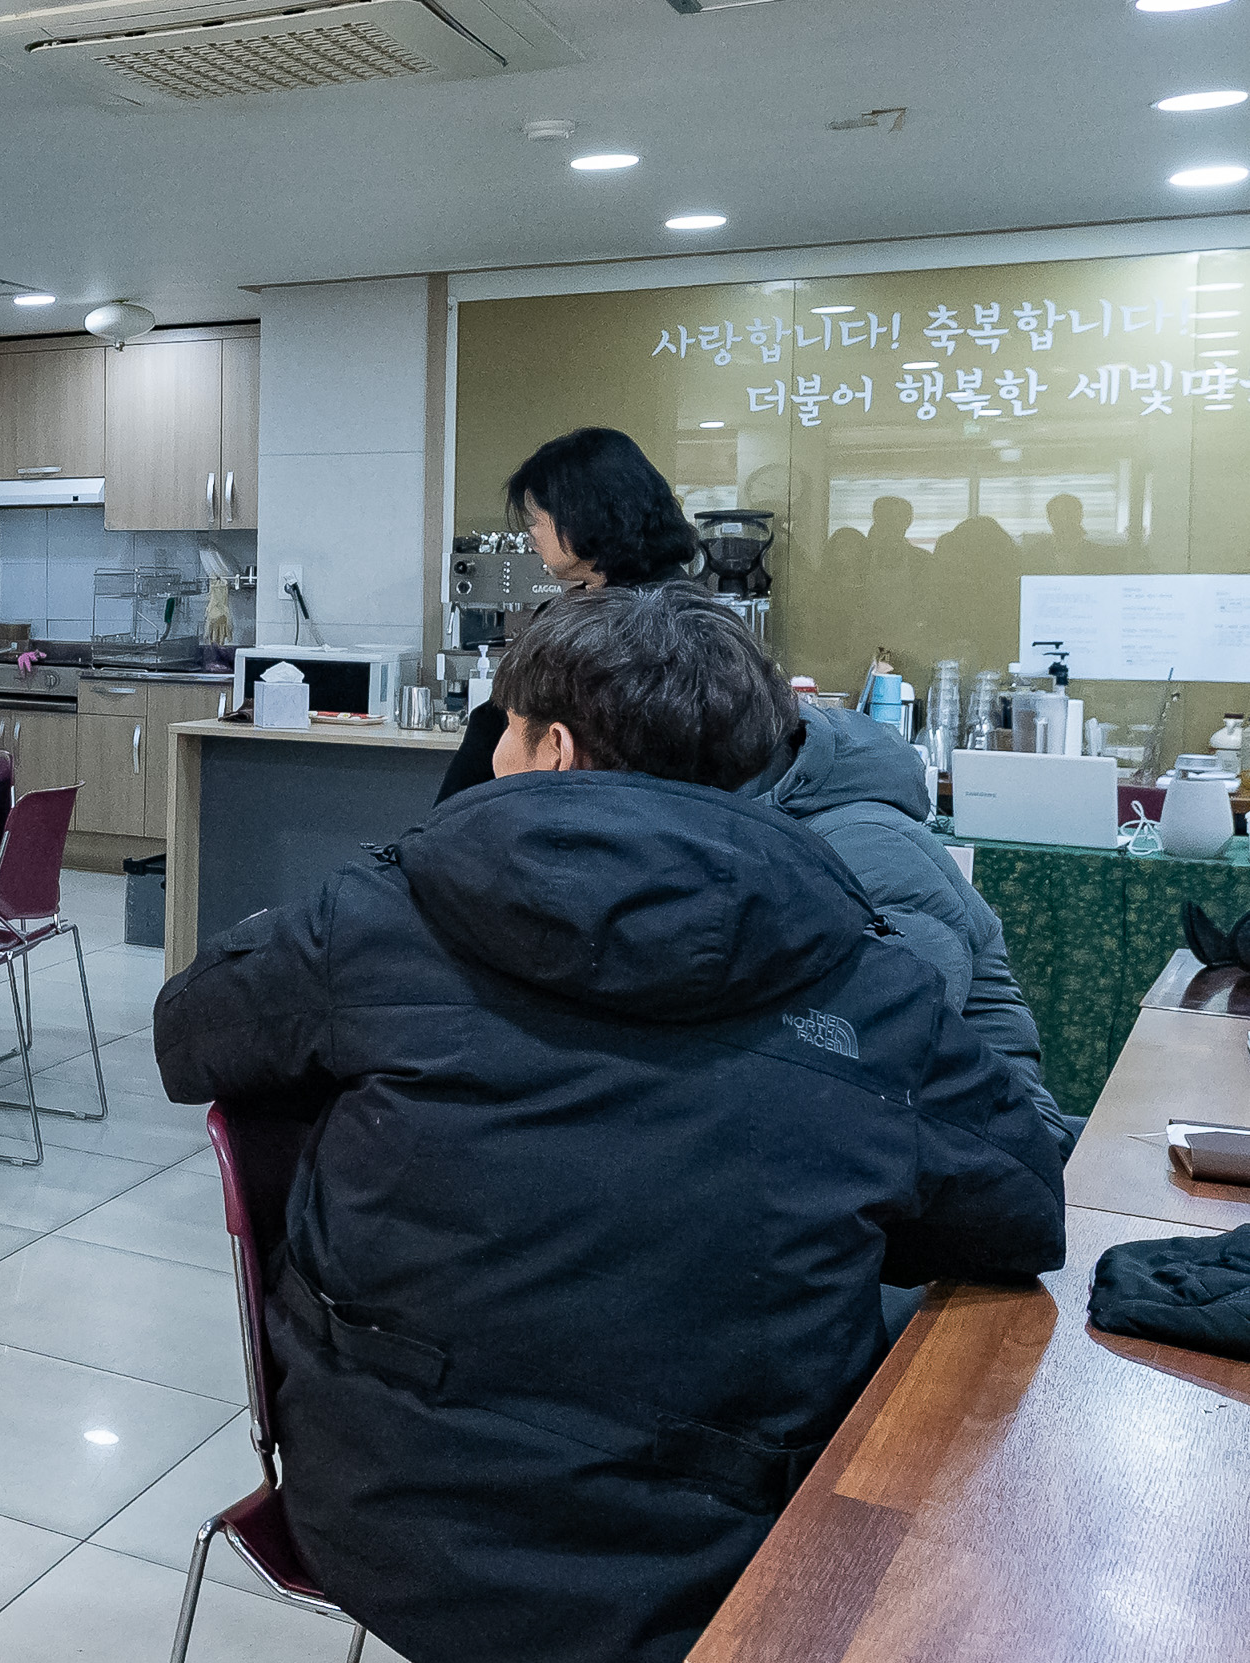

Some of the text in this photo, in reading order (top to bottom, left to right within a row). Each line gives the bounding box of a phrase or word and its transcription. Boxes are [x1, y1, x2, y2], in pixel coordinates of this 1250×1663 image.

[651, 311, 902, 367] 사랑합니다!
[746, 373, 874, 428] 더불어
[895, 367, 1050, 421] 행복한
[532, 584, 562, 594] GAGGIA
[782, 1013, 837, 1037] NORTH
[808, 1008, 838, 1027] THE
[797, 1030, 835, 1051] FACE
